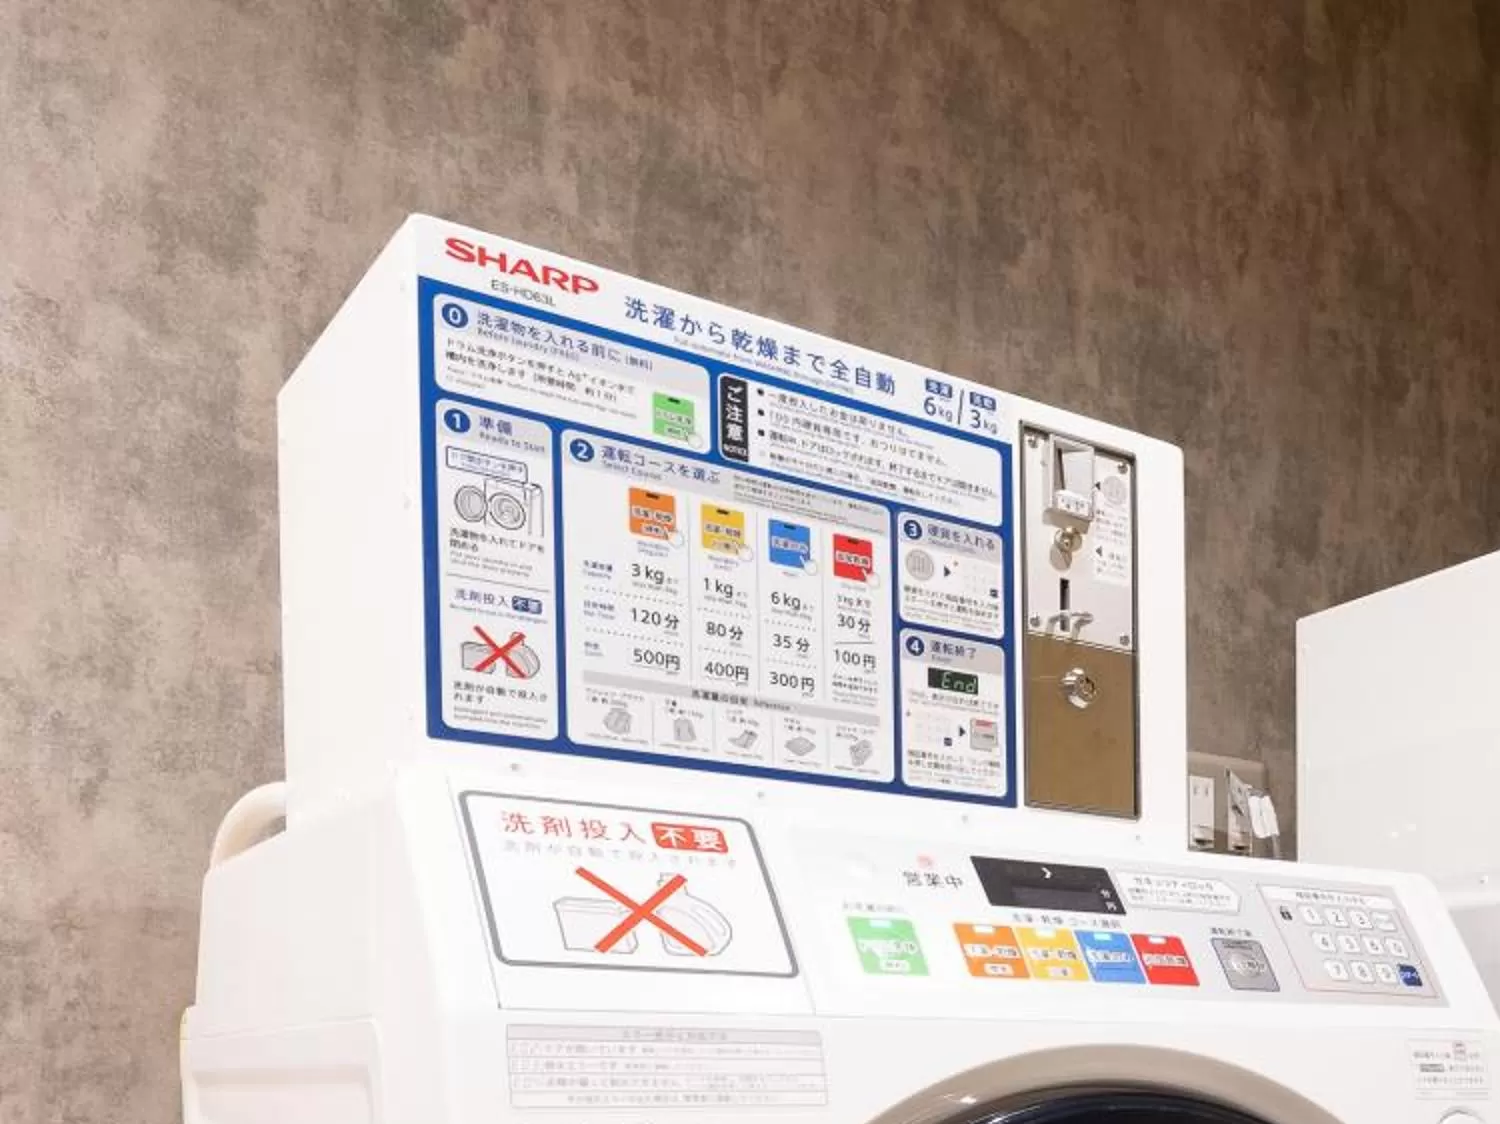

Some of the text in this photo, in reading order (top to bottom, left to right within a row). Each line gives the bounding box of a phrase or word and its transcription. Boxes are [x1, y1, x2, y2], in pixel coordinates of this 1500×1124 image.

[445, 237, 599, 294] SHARP
[477, 310, 621, 363] 洗濯物を入れる前に
[624, 295, 897, 397] 洗濯から乾燥まで全自動
[452, 413, 461, 429] 1
[575, 443, 589, 460] 2
[601, 445, 721, 484] 運転コースを選ぶ
[632, 563, 641, 577] 3
[645, 565, 664, 584] kg
[715, 580, 733, 598] kg
[771, 591, 780, 605] 6
[783, 593, 801, 611] kg
[631, 607, 679, 630] 120分
[836, 613, 871, 633] 30分
[706, 621, 744, 641] 80分
[772, 633, 811, 653] 35分
[910, 640, 920, 654] 4
[633, 648, 681, 671] 500円
[834, 649, 876, 669] 100円
[704, 661, 749, 681] 400円
[769, 671, 815, 693] 300円
[941, 671, 977, 694] End
[501, 810, 724, 851] 洗剤投入 不要
[903, 871, 963, 889] 営業中
